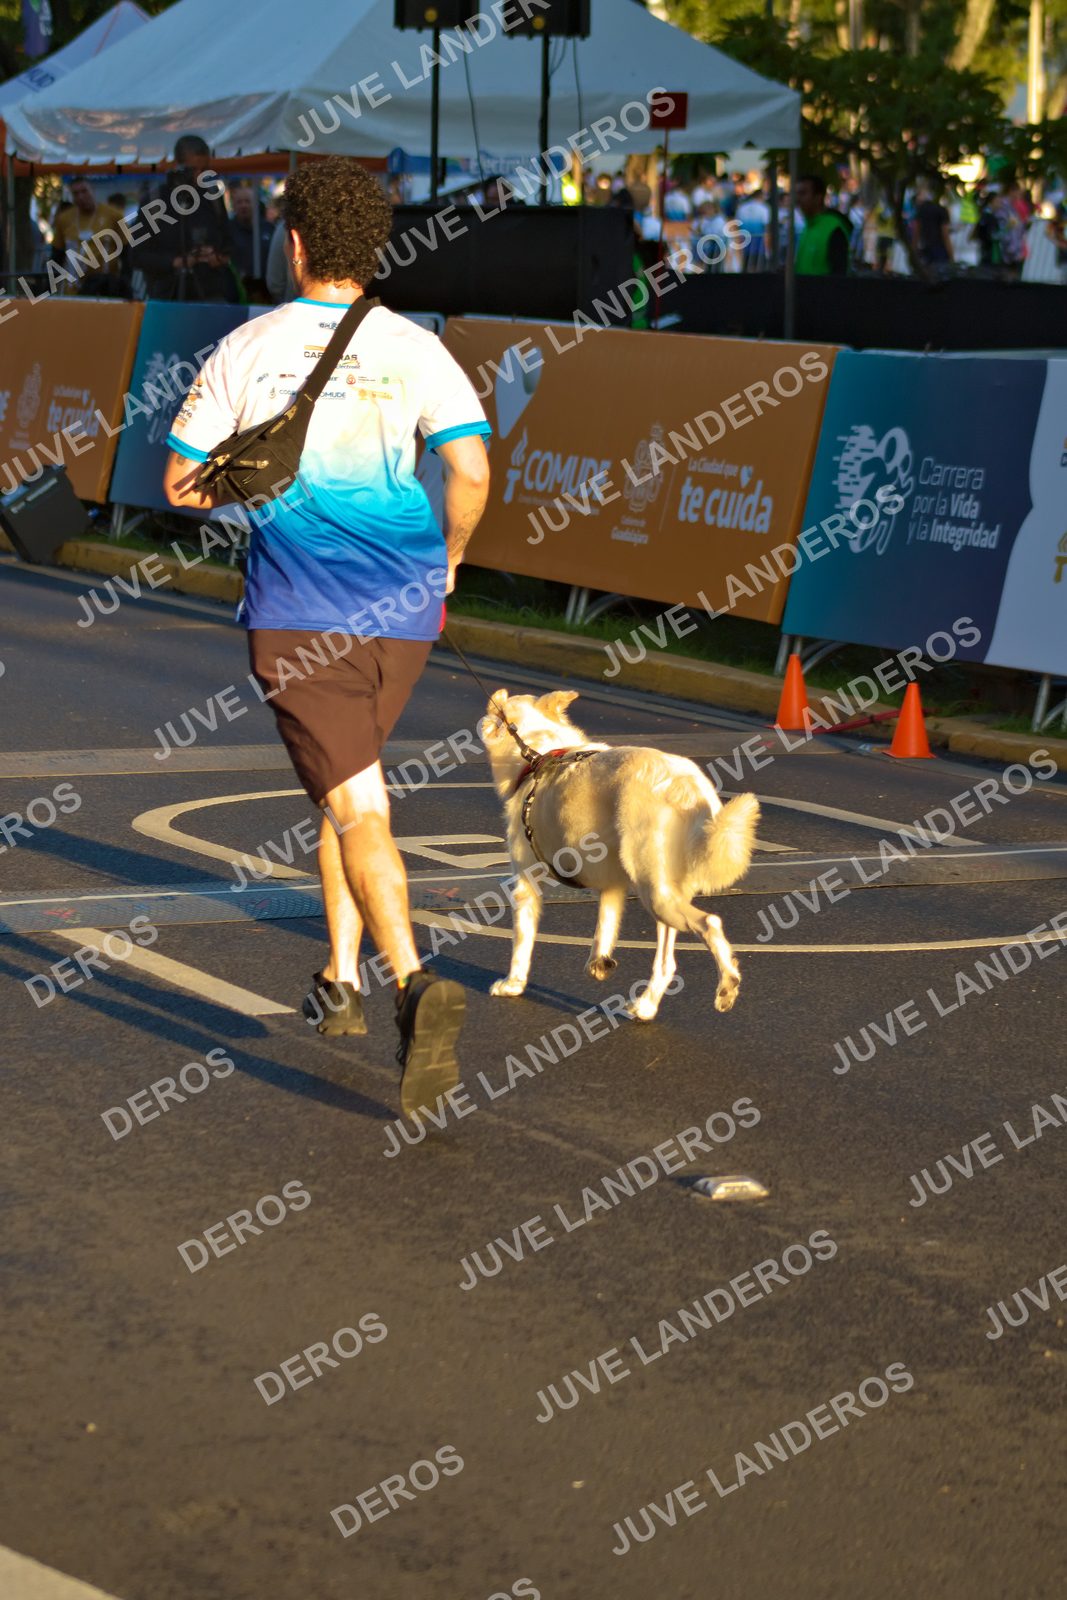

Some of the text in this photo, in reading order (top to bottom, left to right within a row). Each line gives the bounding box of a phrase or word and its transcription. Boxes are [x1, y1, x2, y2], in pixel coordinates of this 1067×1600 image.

[523, 449, 613, 500] COMUDE
[919, 457, 986, 490] Carrera
[677, 475, 774, 534] te cuida
[911, 490, 980, 520] por la Vida
[906, 514, 1001, 551] y la Integridad
